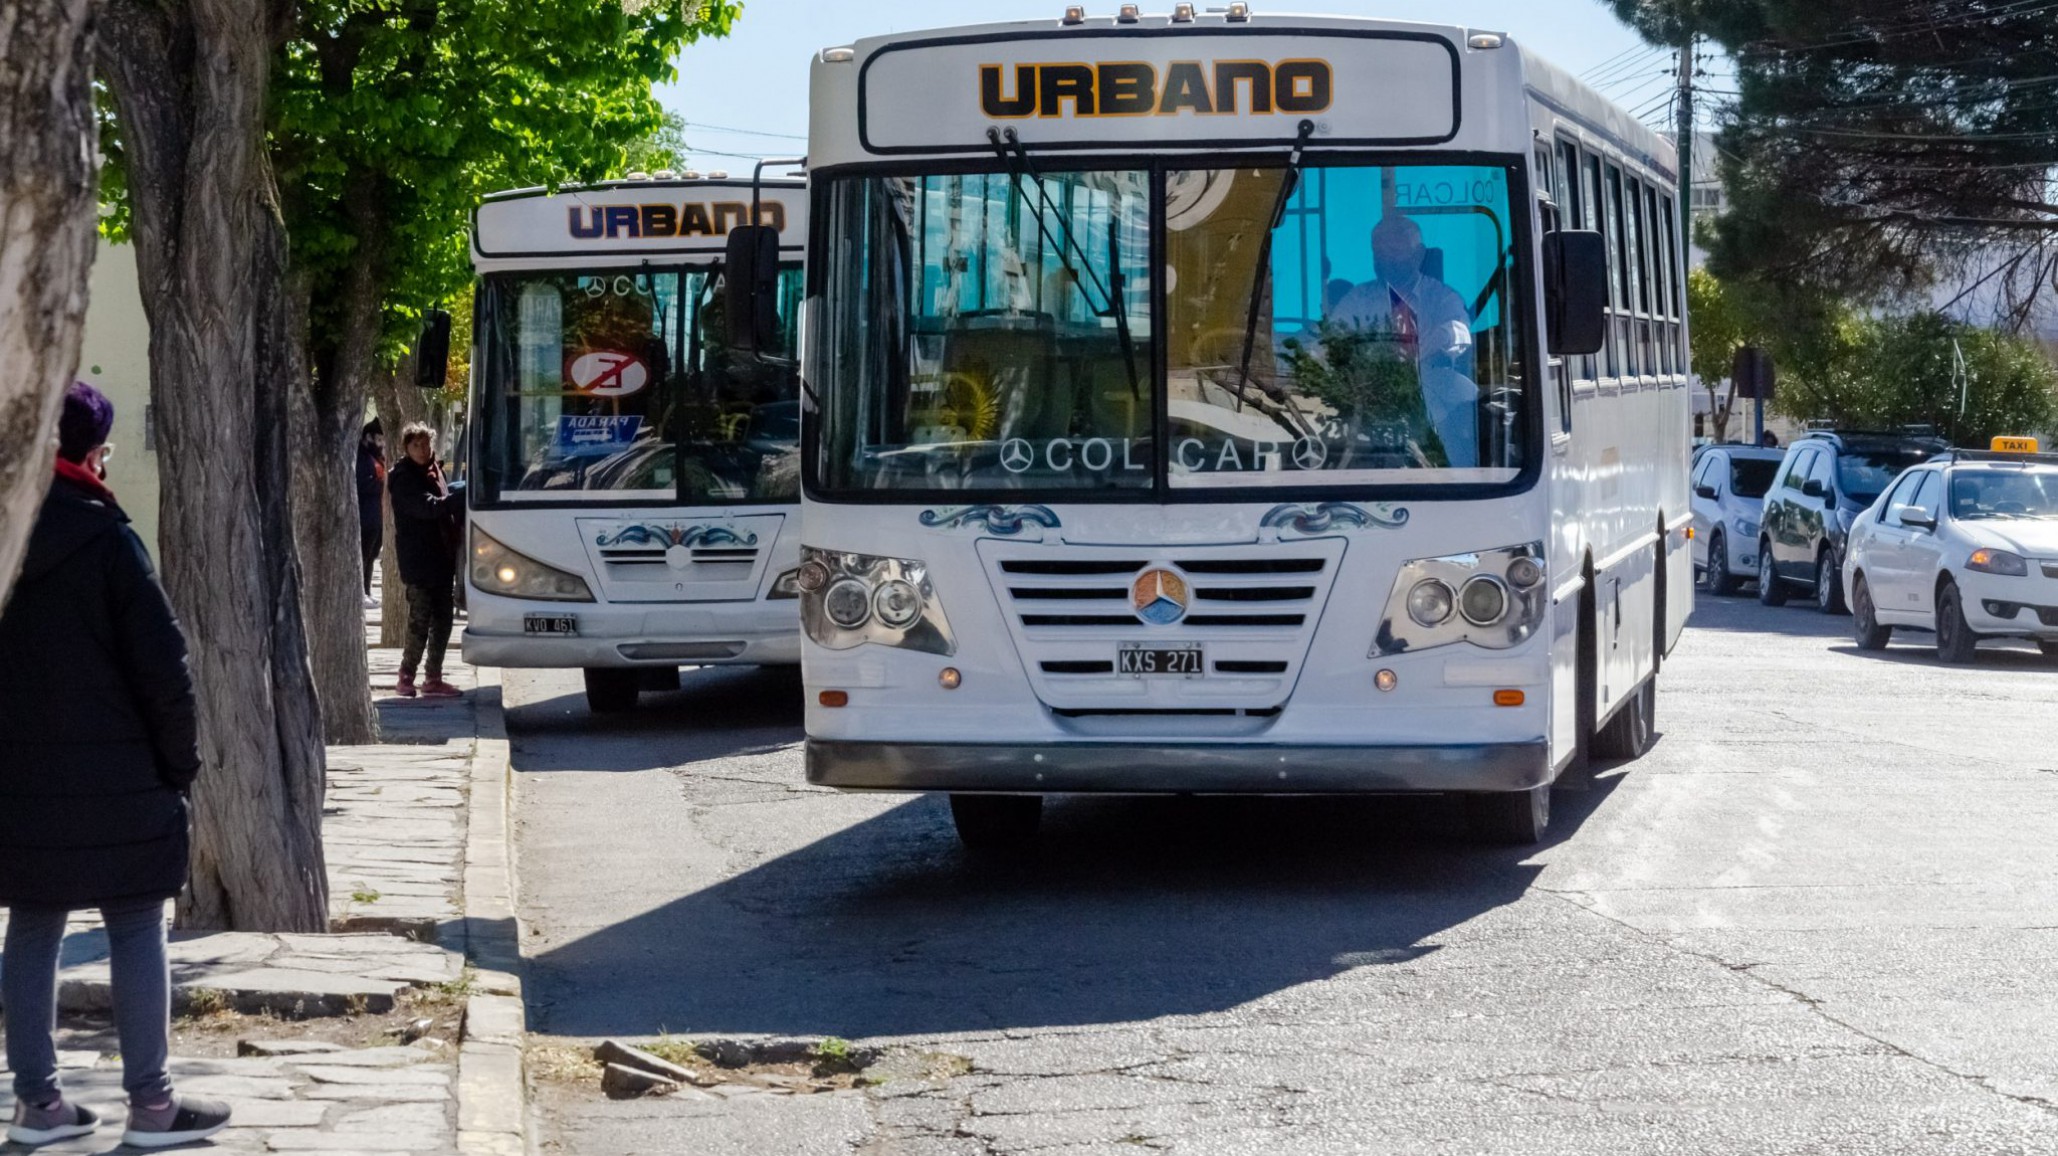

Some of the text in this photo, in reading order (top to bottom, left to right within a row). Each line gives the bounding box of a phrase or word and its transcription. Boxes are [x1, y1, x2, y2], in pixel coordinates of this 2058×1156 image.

[979, 58, 1333, 119] URBANO
[568, 199, 786, 239] URBANO
[2002, 441, 2028, 450] TAXI
[1121, 651, 1201, 672] KXS 271
